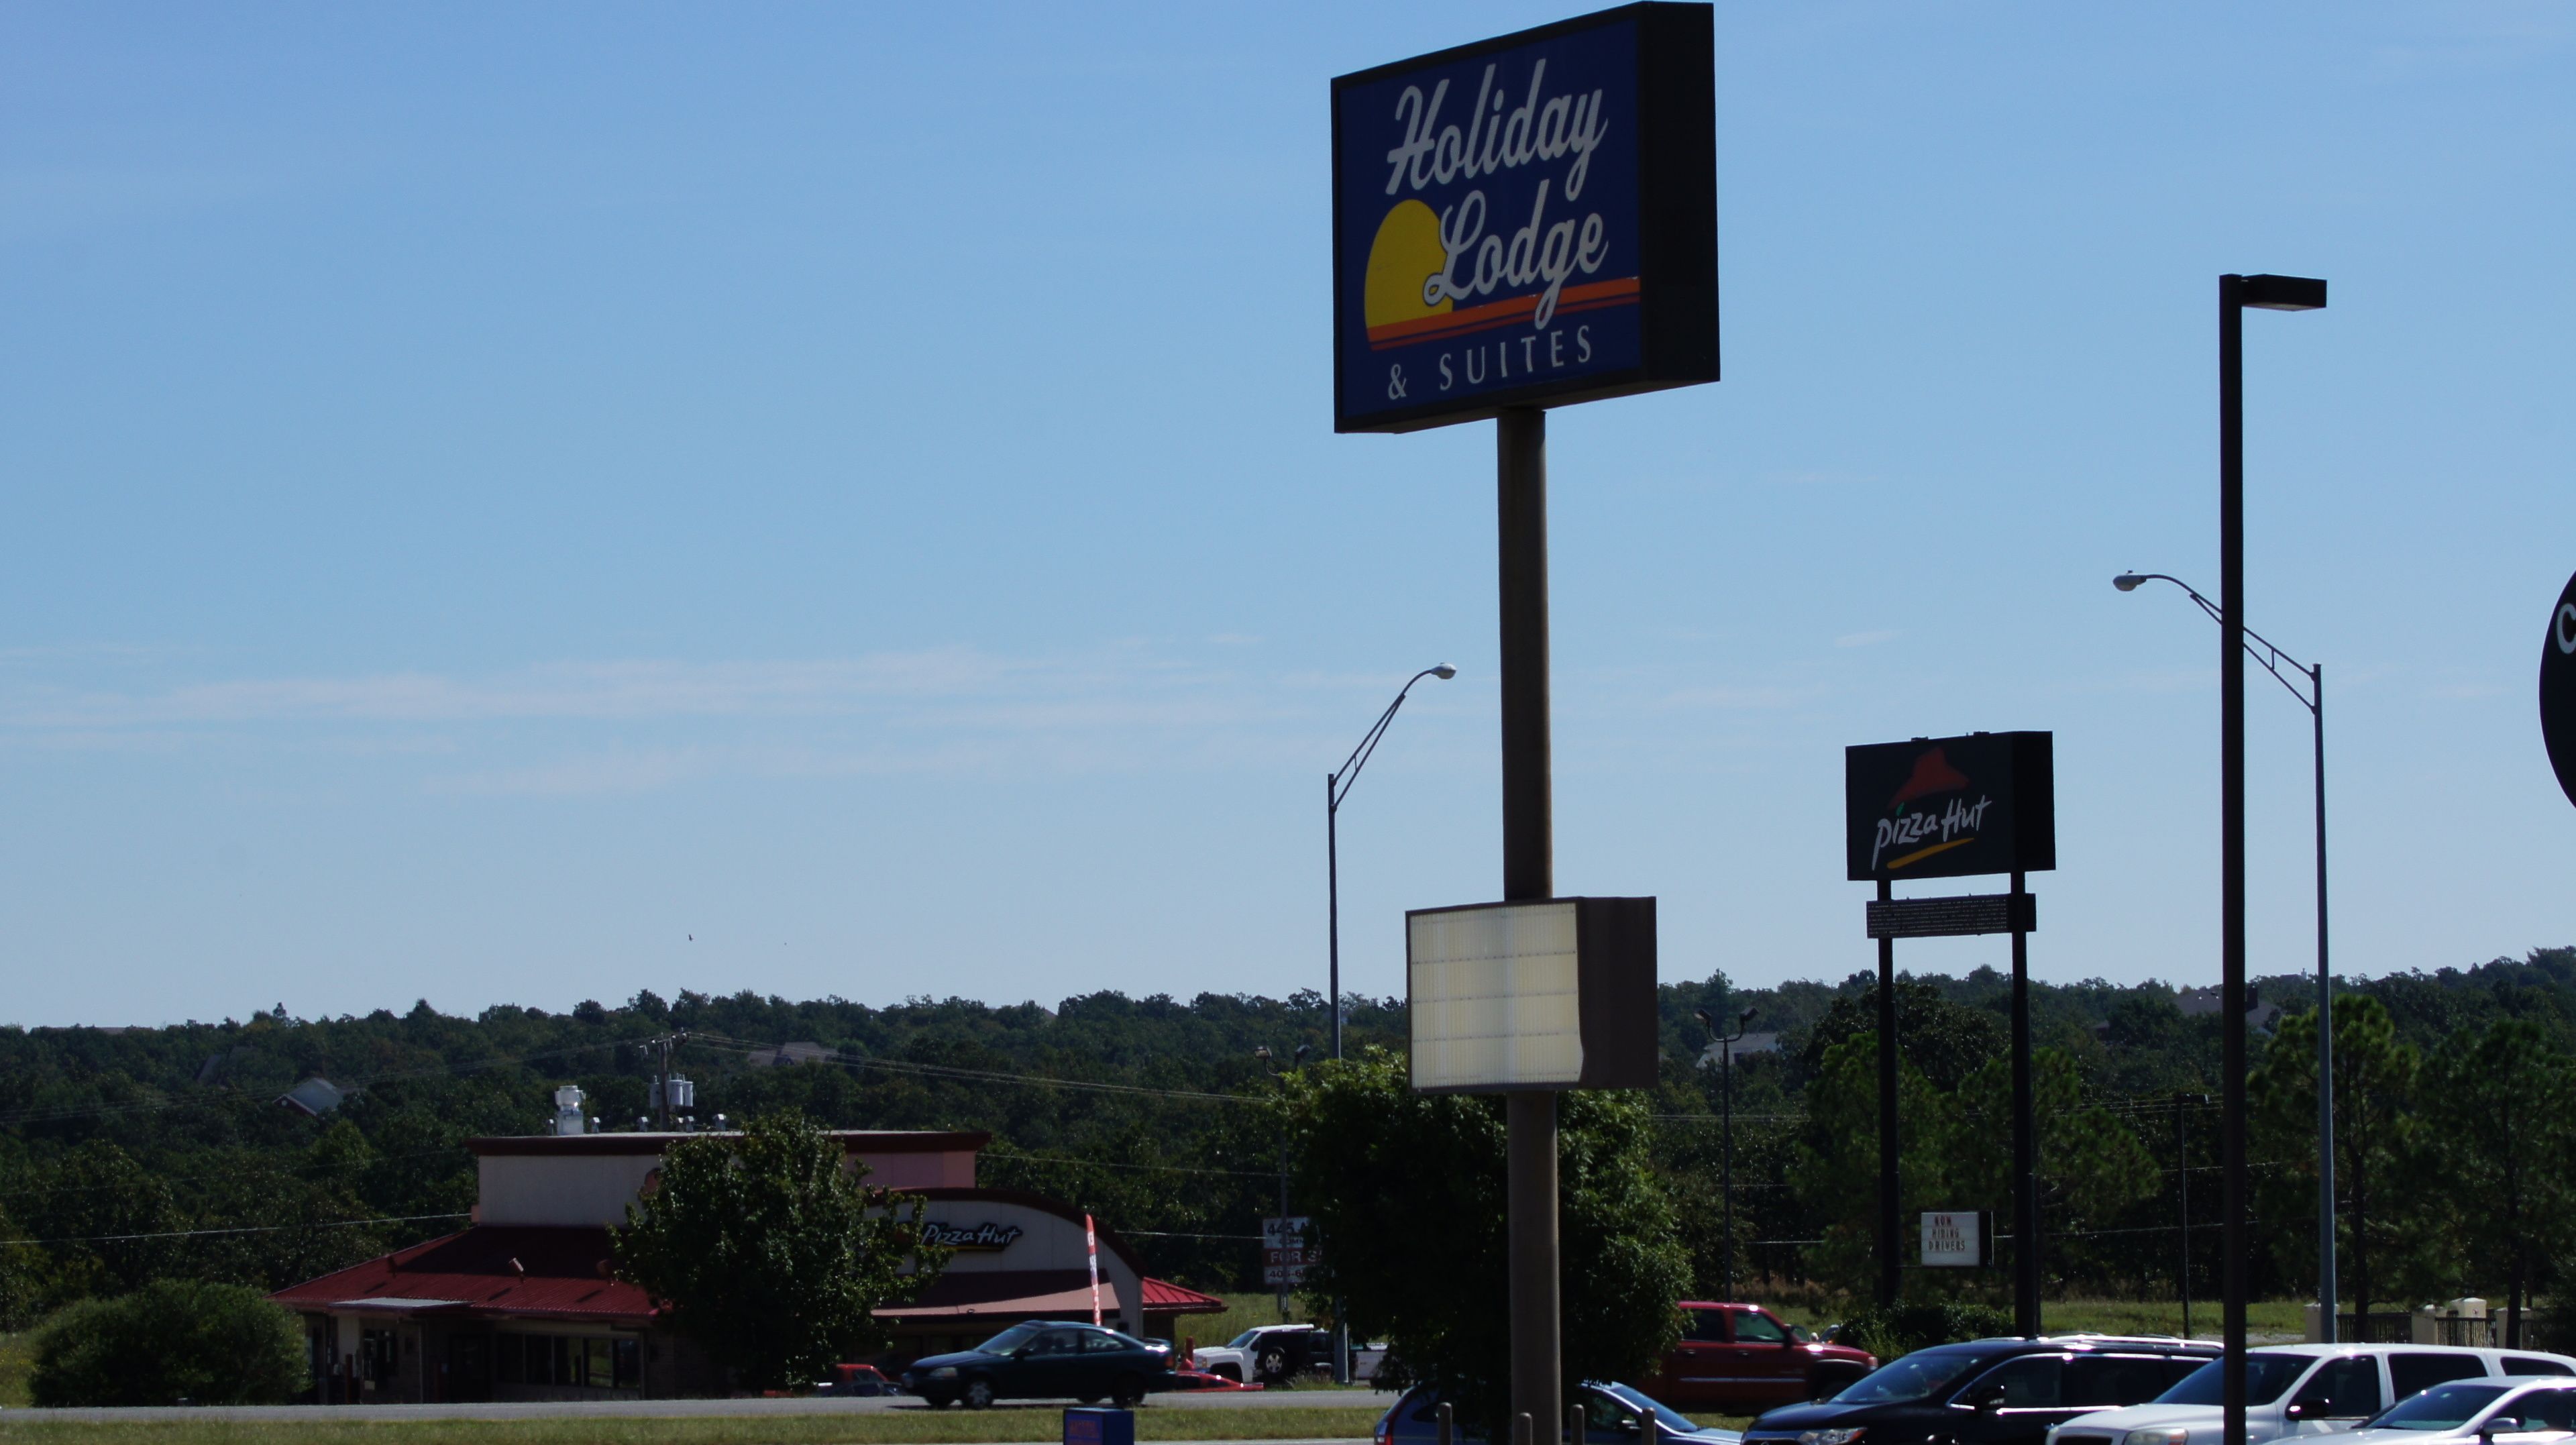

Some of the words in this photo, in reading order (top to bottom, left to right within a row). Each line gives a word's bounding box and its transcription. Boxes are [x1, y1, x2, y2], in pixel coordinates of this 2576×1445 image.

[1385, 58, 1609, 201] Holiday
[1424, 178, 1609, 329] Lodge
[1388, 364, 1407, 400] &
[1440, 325, 1592, 390] SUITES
[1872, 808, 1939, 871] Pizza
[1941, 795, 1992, 842] Hut
[921, 1224, 974, 1245] Pizza
[977, 1225, 1021, 1244] Hut
[1271, 1250, 1302, 1264] FOR
[1929, 1240, 1966, 1251] DRIVERS
